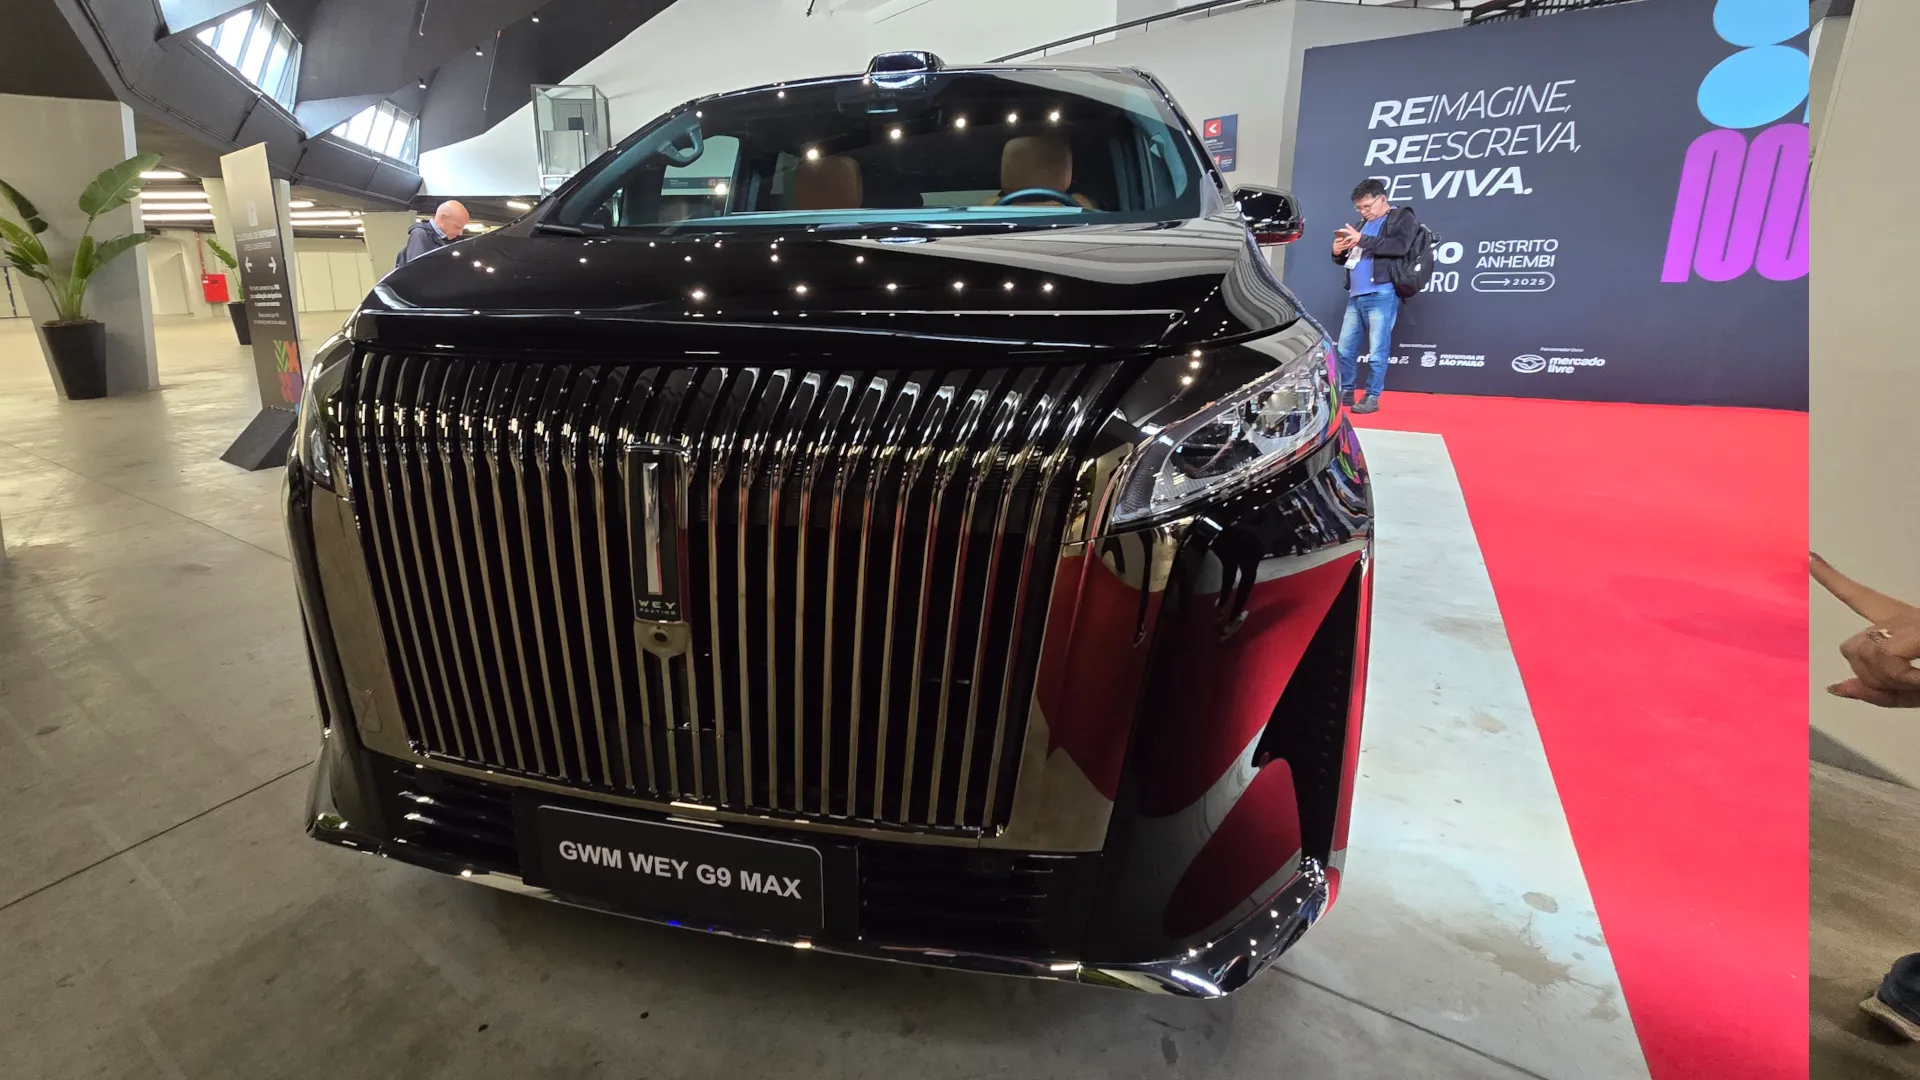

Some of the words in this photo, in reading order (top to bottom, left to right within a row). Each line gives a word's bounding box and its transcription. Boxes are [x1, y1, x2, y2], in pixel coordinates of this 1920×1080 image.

[1368, 79, 1576, 130] REIMAGINE,
[1363, 121, 1582, 167] REESCREVA,
[1478, 238, 1559, 254] DISTRITO
[1475, 254, 1556, 269] ANHEMBI
[1512, 278, 1546, 286] 2025
[1438, 358, 1457, 366] SÃO
[1549, 357, 1606, 366] mercado
[1547, 364, 1575, 374] livre
[638, 600, 676, 610] WEY
[559, 840, 623, 869] GWM
[628, 851, 689, 880] WEY
[696, 863, 732, 888] G9
[740, 870, 802, 900] MAX
